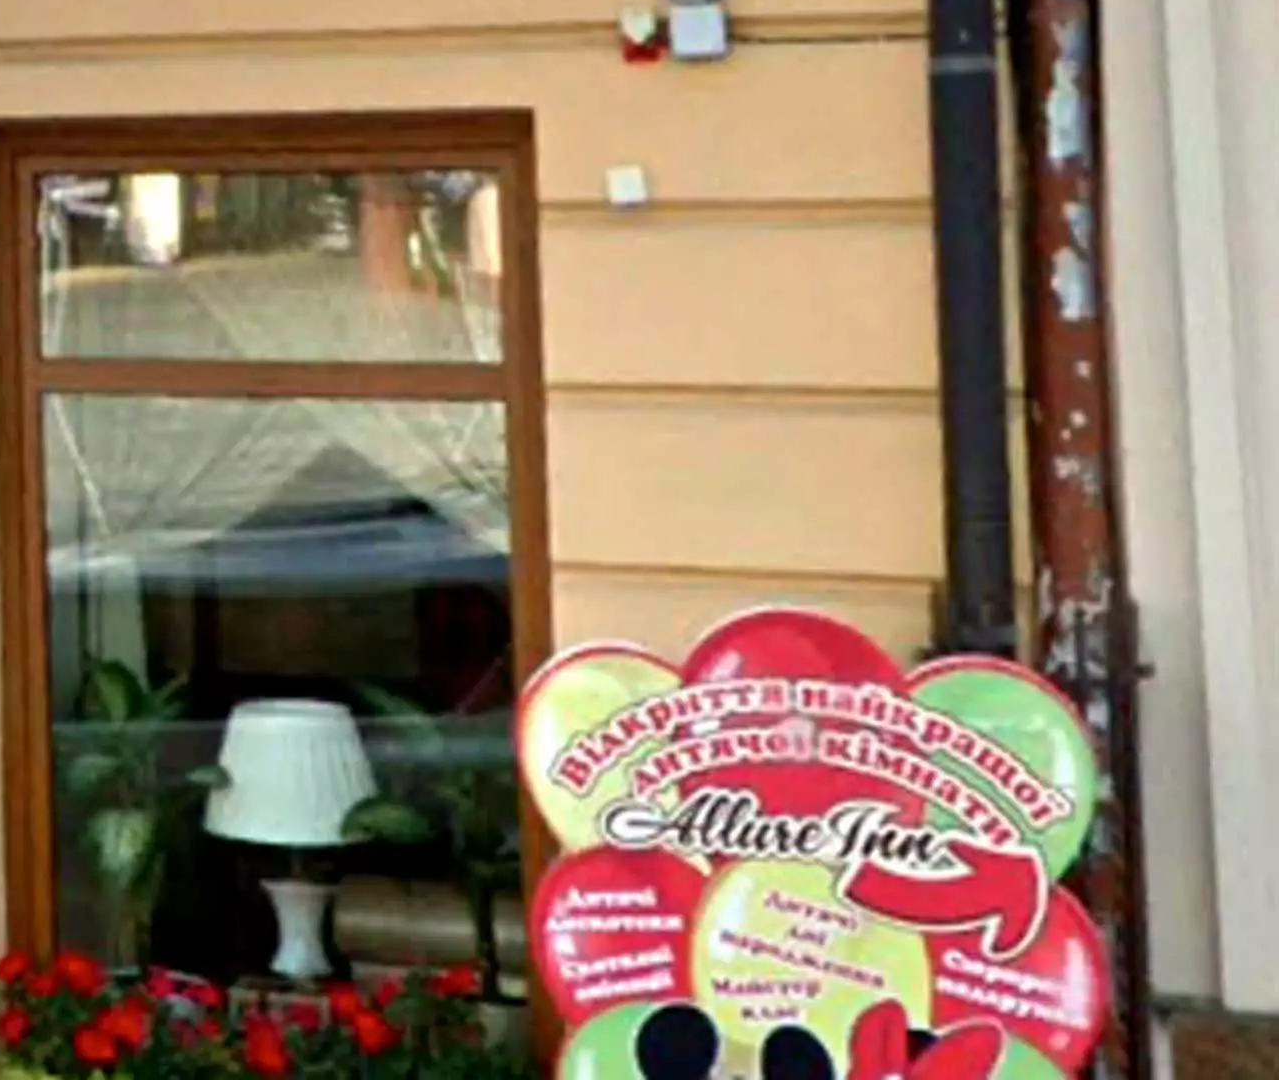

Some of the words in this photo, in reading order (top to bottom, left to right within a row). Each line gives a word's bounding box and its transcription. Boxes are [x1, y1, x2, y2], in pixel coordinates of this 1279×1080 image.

[555, 682, 788, 792] Відкриття
[799, 684, 1071, 822] найкращої
[634, 724, 811, 798] дитячої
[822, 733, 1015, 848] кімнати
[603, 791, 828, 856] Allure
[825, 800, 957, 863] Inn
